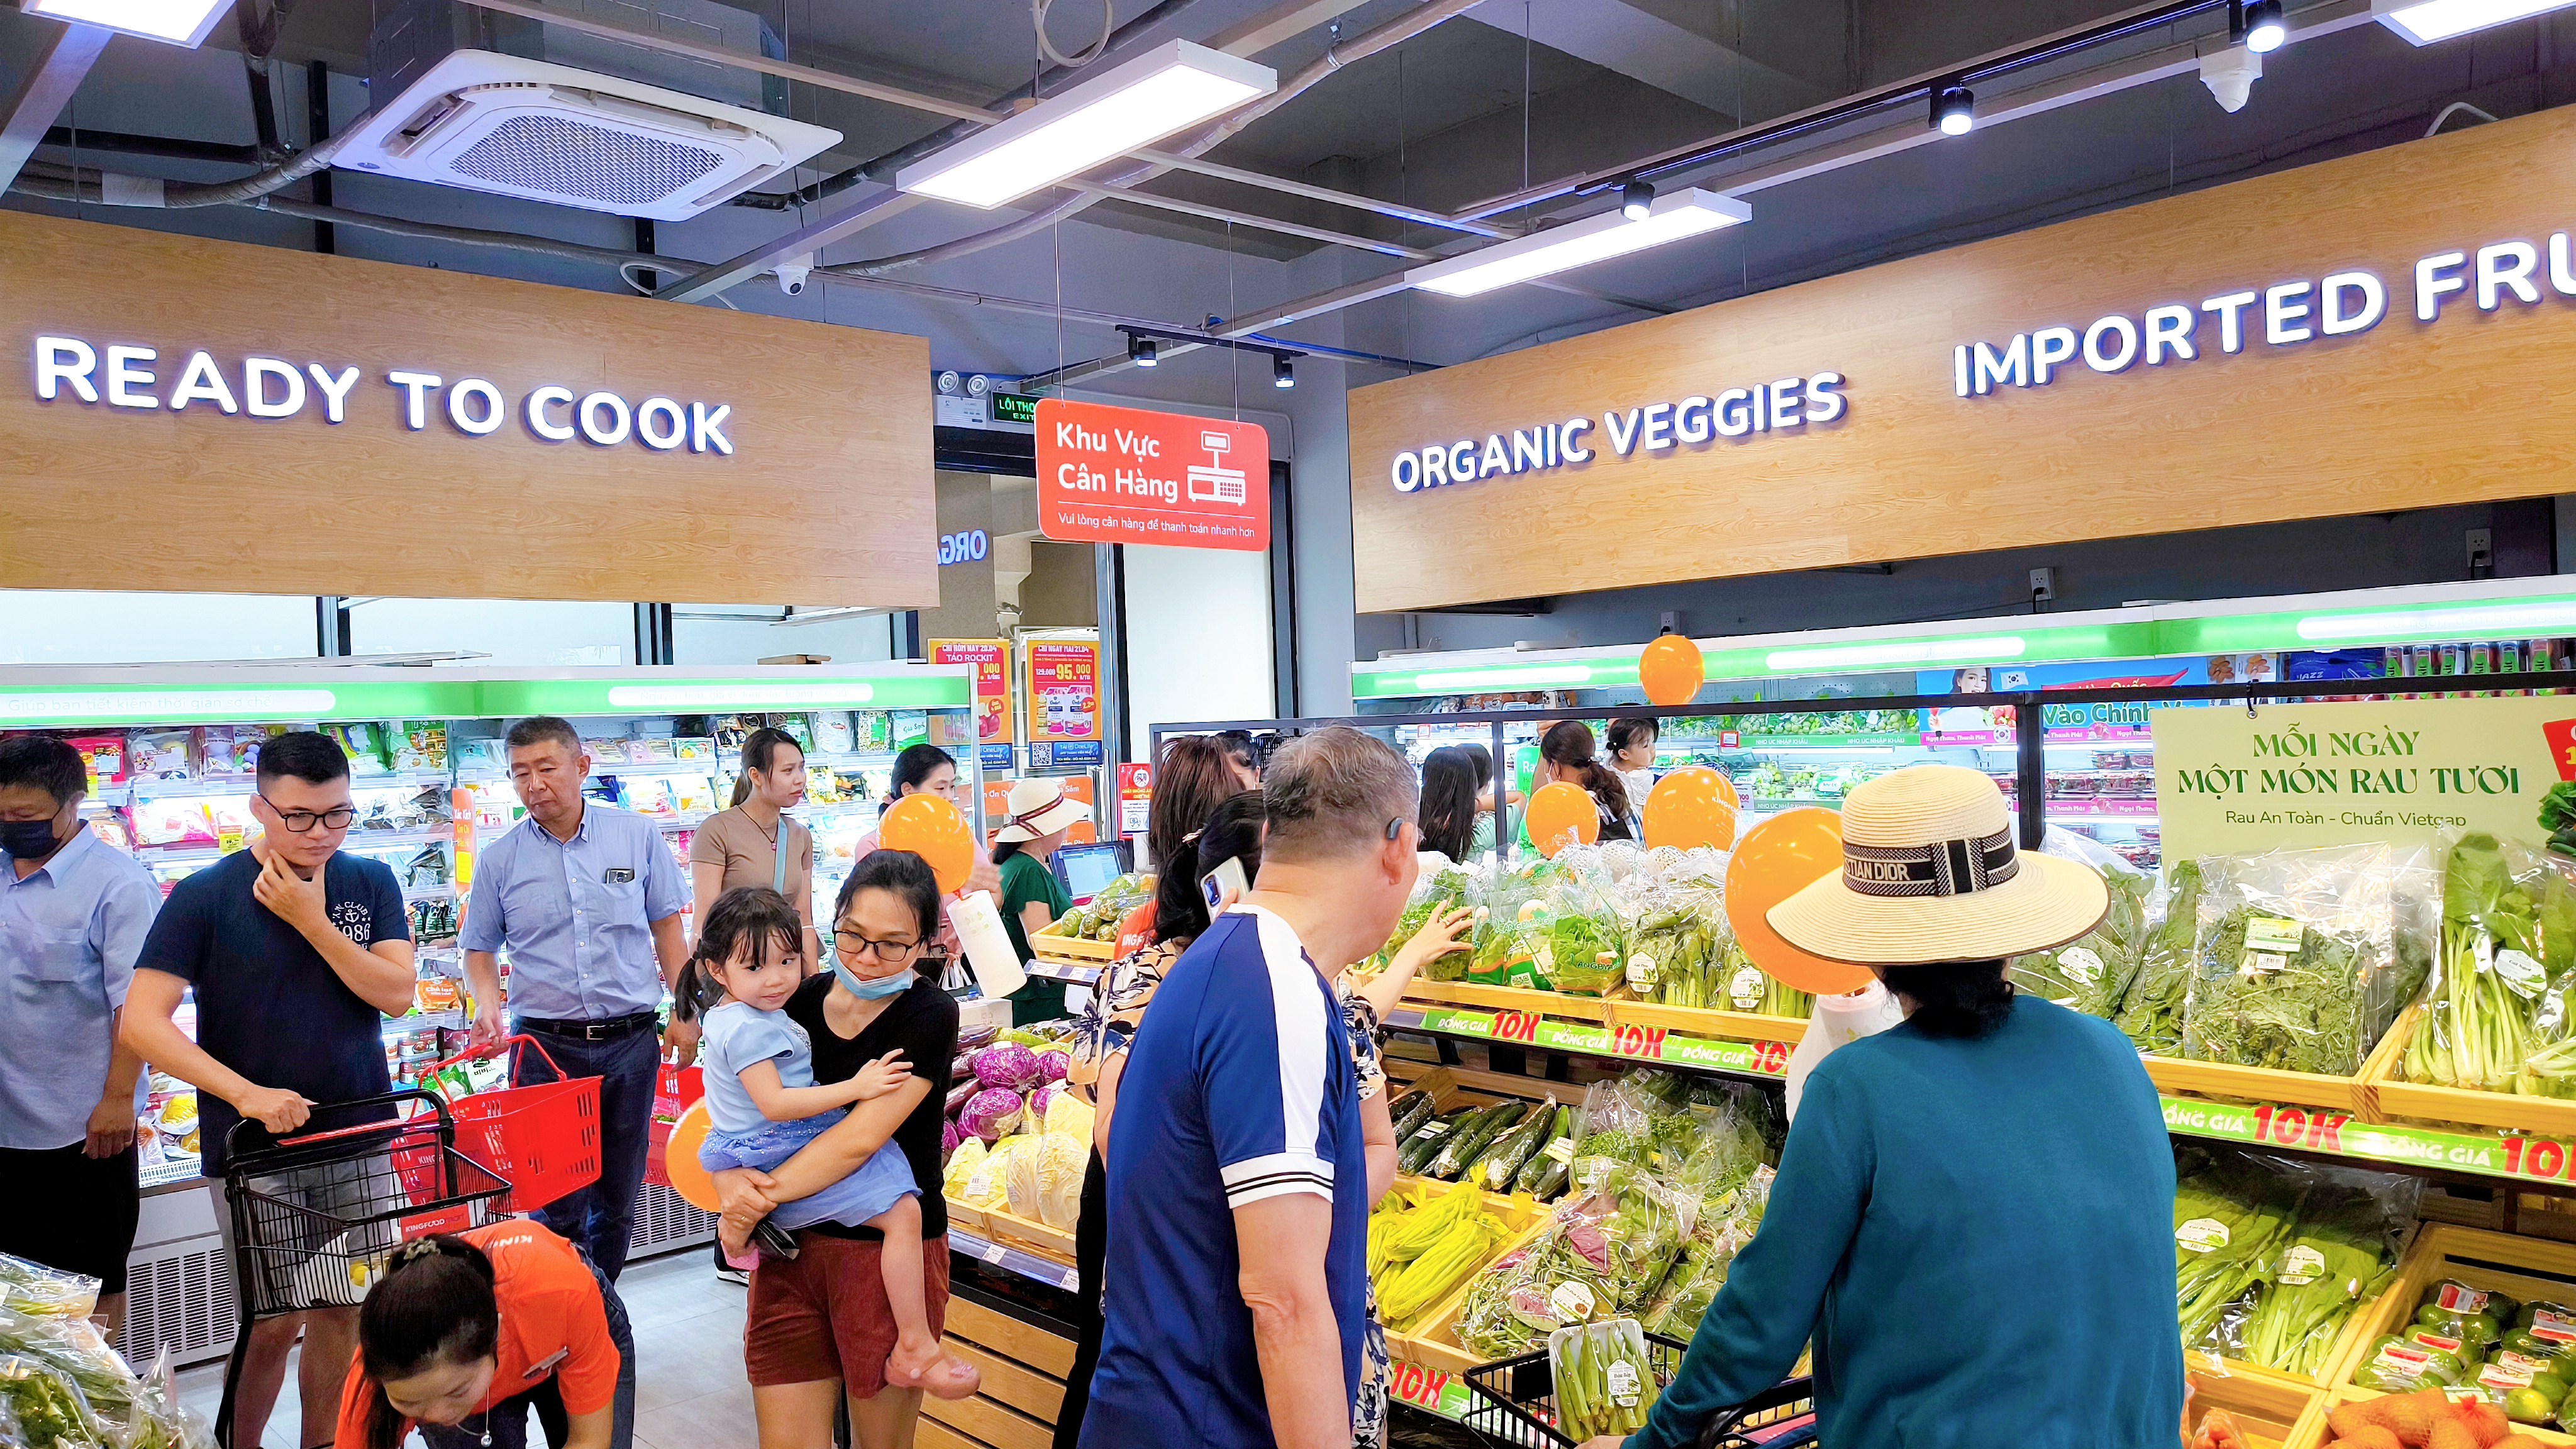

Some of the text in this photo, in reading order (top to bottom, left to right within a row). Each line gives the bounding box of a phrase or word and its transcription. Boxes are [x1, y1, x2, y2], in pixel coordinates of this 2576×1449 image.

[1953, 270, 2387, 397] IMPORTED
[36, 335, 735, 455] READY TO COOK
[1017, 401, 1035, 413] THO
[1056, 421, 1160, 462] Khu Vực
[1391, 371, 1847, 493] ORGANIC VEGGIES
[1057, 462, 1178, 503] Cân Hàng
[1058, 511, 1255, 537] Vui lòng cân hàng để thanh toán nhanh hơn
[946, 652, 963, 662] TÁO
[191, 697, 221, 710] gian
[2043, 702, 2152, 724] Vào Chính
[2252, 721, 2420, 758] MỖI NGÀY
[2177, 762, 2519, 800] MỘT MÓN RAU TƯƠI
[2226, 811, 2255, 824] Rau
[2260, 811, 2281, 824] An
[2285, 810, 2324, 825] Toàn
[2340, 809, 2394, 826] Chuẩn
[2398, 811, 2467, 828] Vietgap
[1844, 862, 1911, 880] STIAN DIOR
[344, 901, 369, 916] CLUB
[336, 923, 371, 941] 986
[1438, 1011, 1543, 1042] ĐỒNG GIÁ 10K
[1585, 1032, 1608, 1050] GIÁ
[1611, 1024, 1670, 1059] 10K
[1681, 1041, 1791, 1073] ĐỒNG GIÁ 10
[2163, 1102, 2351, 1152] ỒNG GIÁ 10K
[2448, 1146, 2491, 1167] GIÁ
[1390, 1361, 1449, 1409] 10K
